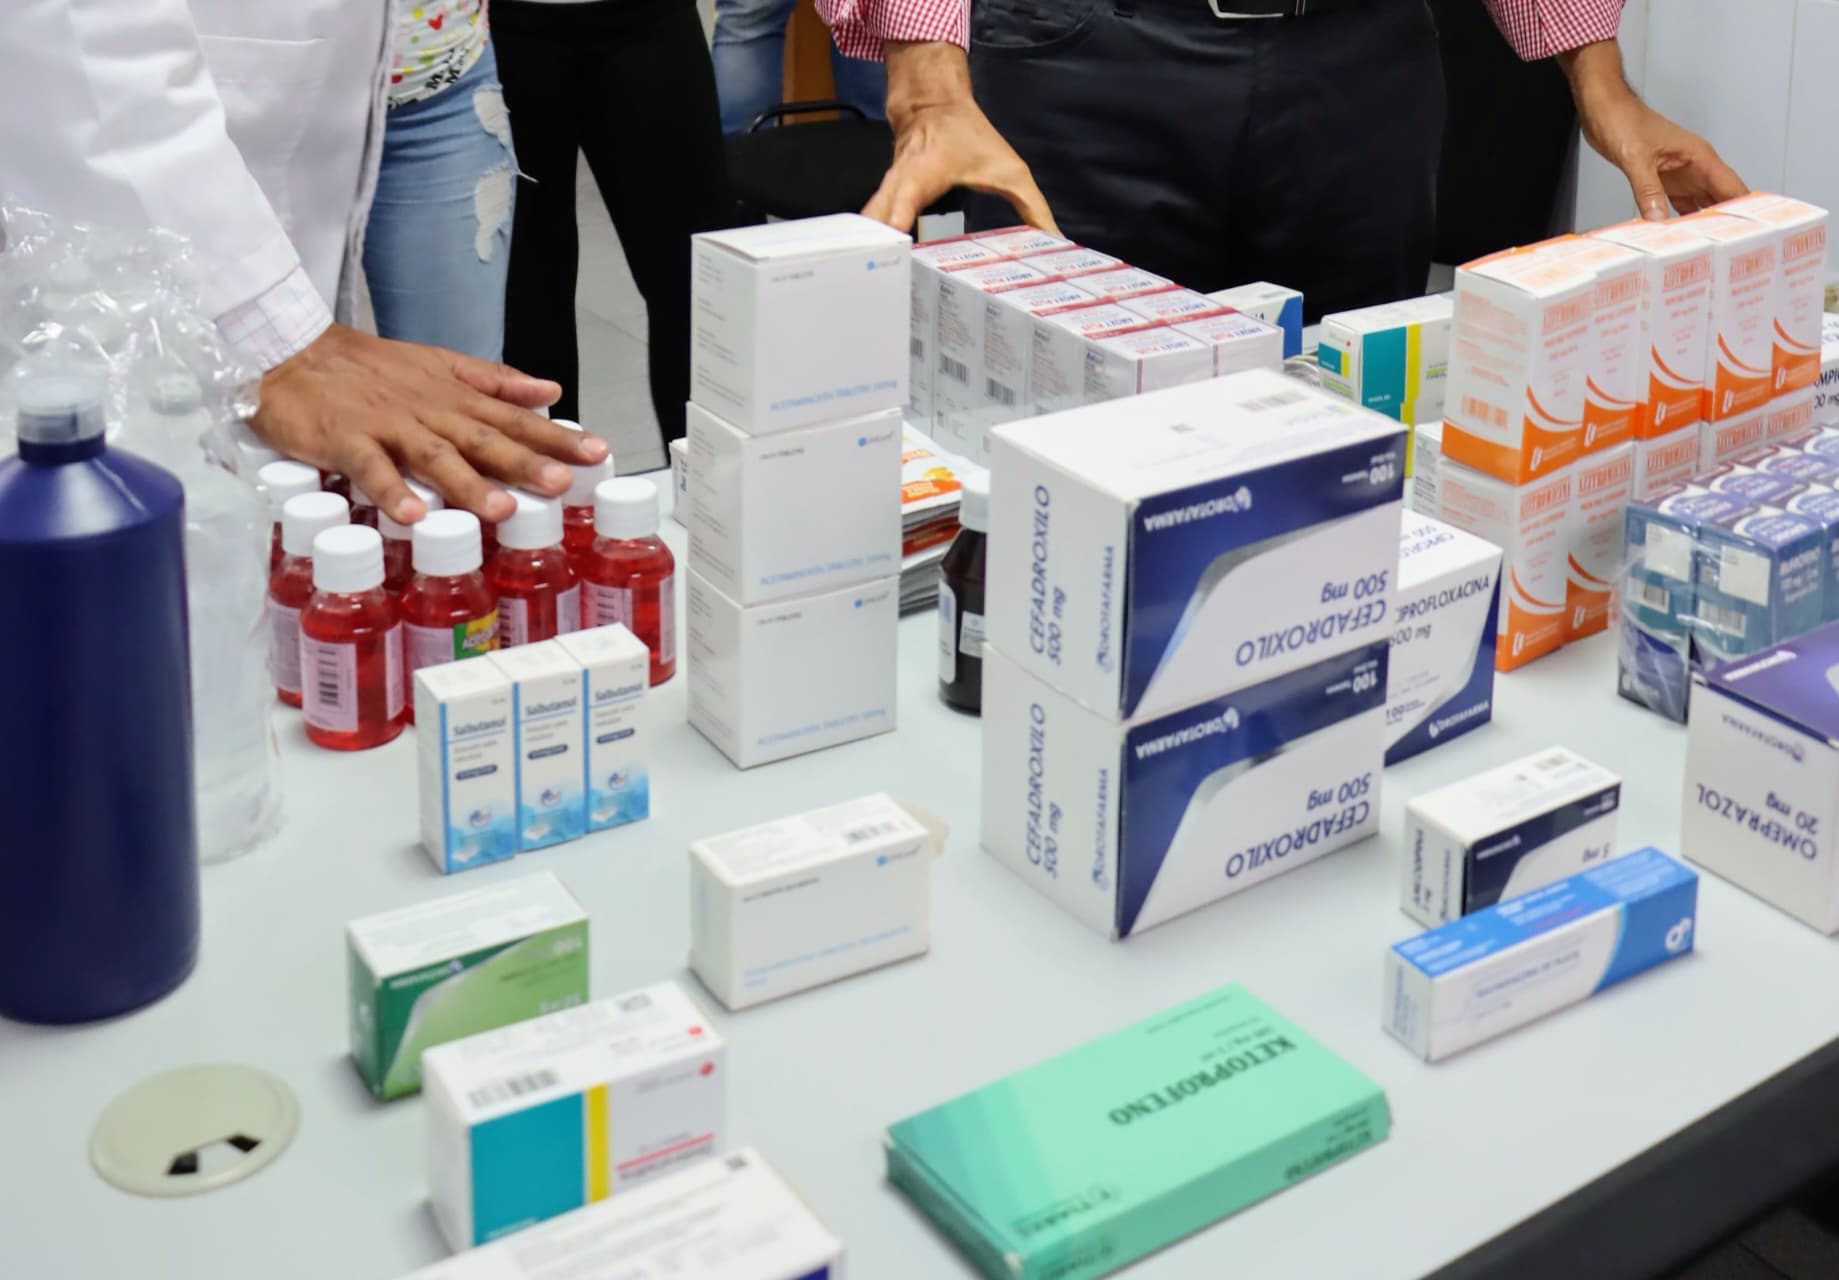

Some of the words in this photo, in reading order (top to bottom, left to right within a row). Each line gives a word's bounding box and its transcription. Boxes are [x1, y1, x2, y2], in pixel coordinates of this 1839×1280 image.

[1030, 484, 1050, 655] CEFADROXILO
[1354, 570, 1388, 600] 500
[1052, 586, 1067, 620] mg
[1321, 582, 1348, 604] mg
[1395, 575, 1490, 624] IPROFLOXACINA
[1047, 621, 1062, 666] 500
[1235, 600, 1387, 667] CEFADROXILO
[1415, 624, 1432, 640] mg
[526, 696, 576, 716] Salbutamol
[595, 681, 643, 701] Salbutamol
[454, 716, 506, 737] Salbutamol
[1026, 703, 1045, 865] CEFADROXILO
[1307, 790, 1333, 810] mg
[1338, 772, 1372, 804] 500
[1048, 802, 1063, 835] mg
[1765, 791, 1791, 816] mg
[1697, 783, 1818, 861] OMEPRAZOL
[1795, 811, 1820, 836] 20
[1225, 800, 1370, 878] CEFADROXILO
[1043, 836, 1059, 879] 500
[1108, 1036, 1297, 1127] KETOPROFENO
